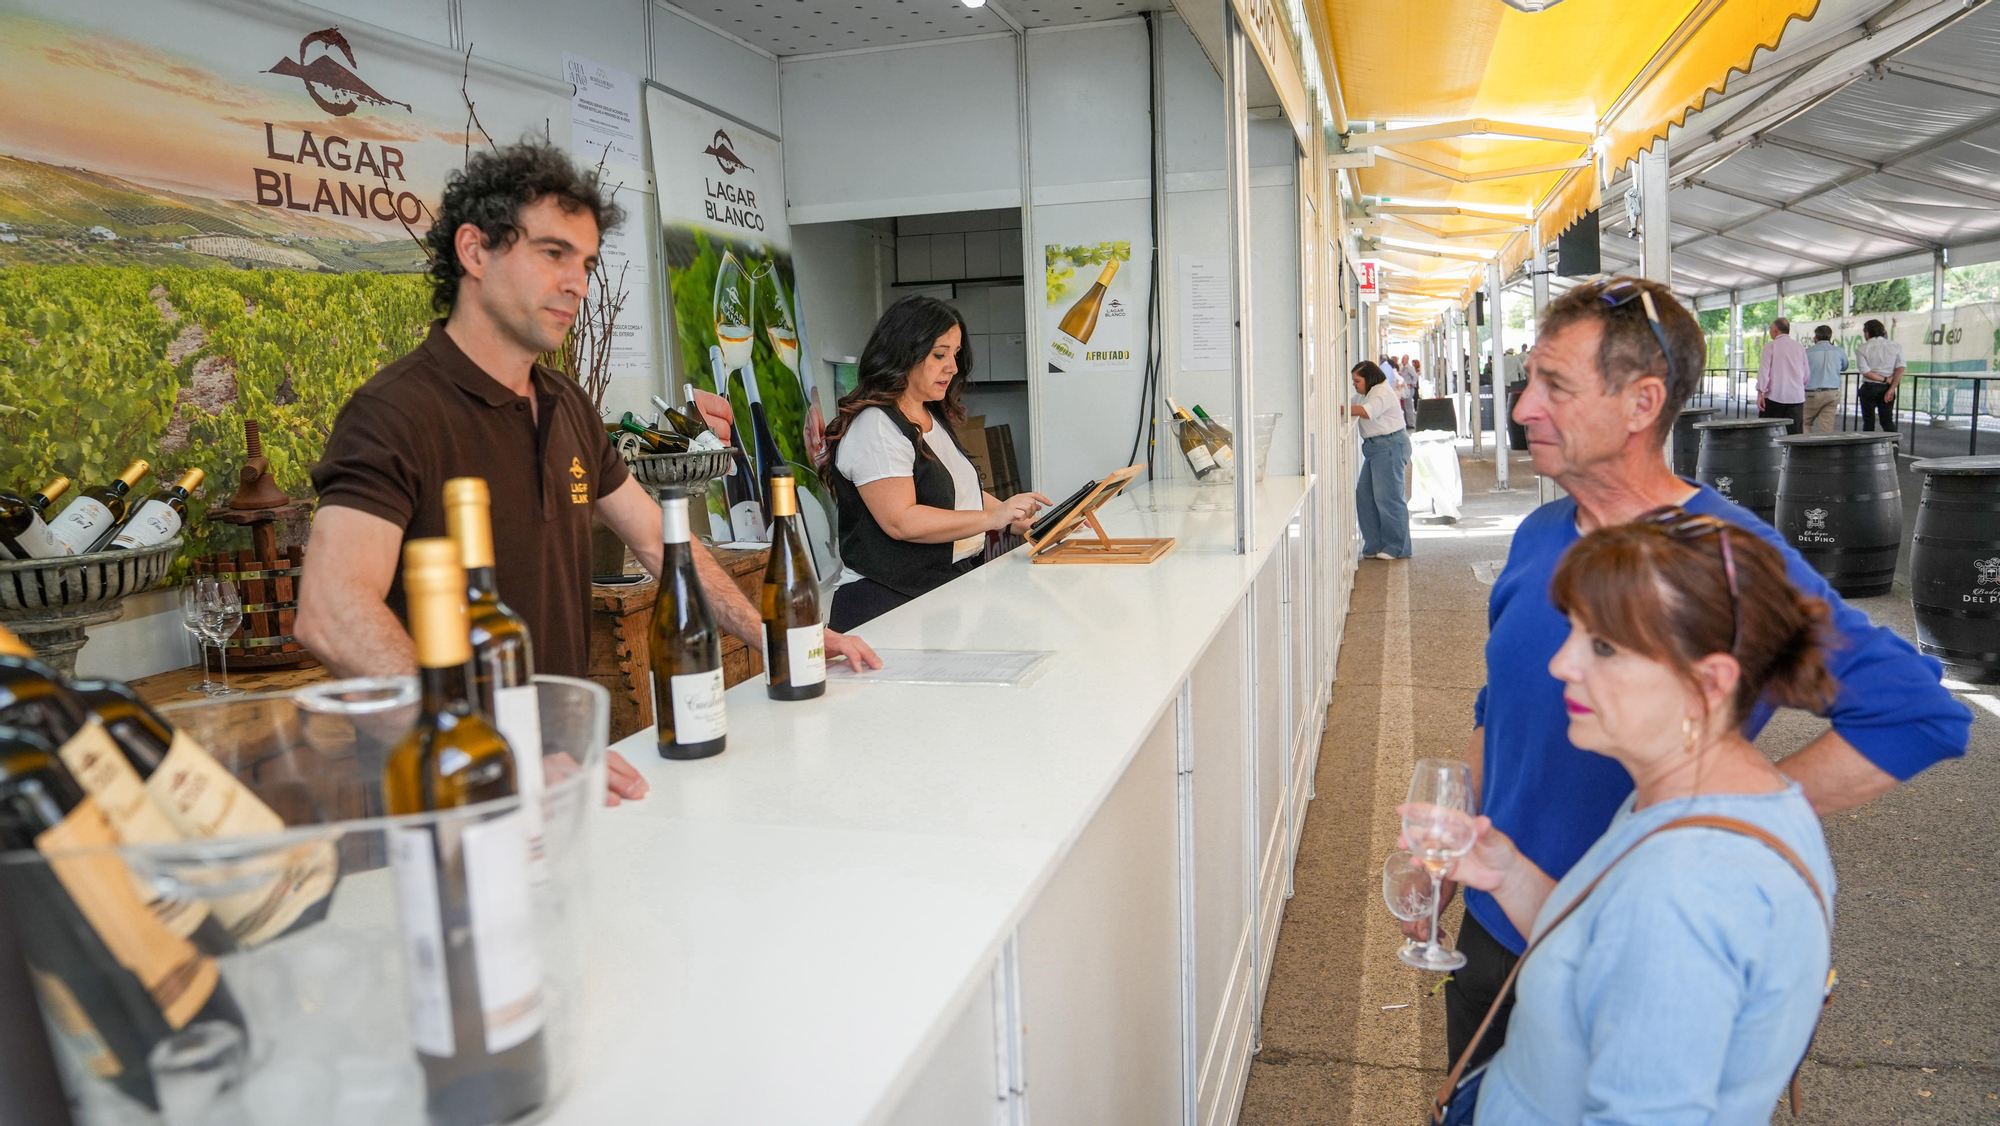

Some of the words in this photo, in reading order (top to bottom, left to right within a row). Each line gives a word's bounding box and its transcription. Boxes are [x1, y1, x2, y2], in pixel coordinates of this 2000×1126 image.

[264, 122, 406, 182] LAGAR
[253, 167, 422, 225] BLANCO
[705, 177, 757, 209] LAGAR
[705, 199, 765, 232] BLANCO
[1085, 350, 1130, 361] AFRUTADO
[82, 521, 94, 530] 7
[159, 527, 169, 535] 7
[1814, 535, 1835, 543] PINO
[1962, 594, 1985, 604] DEL
